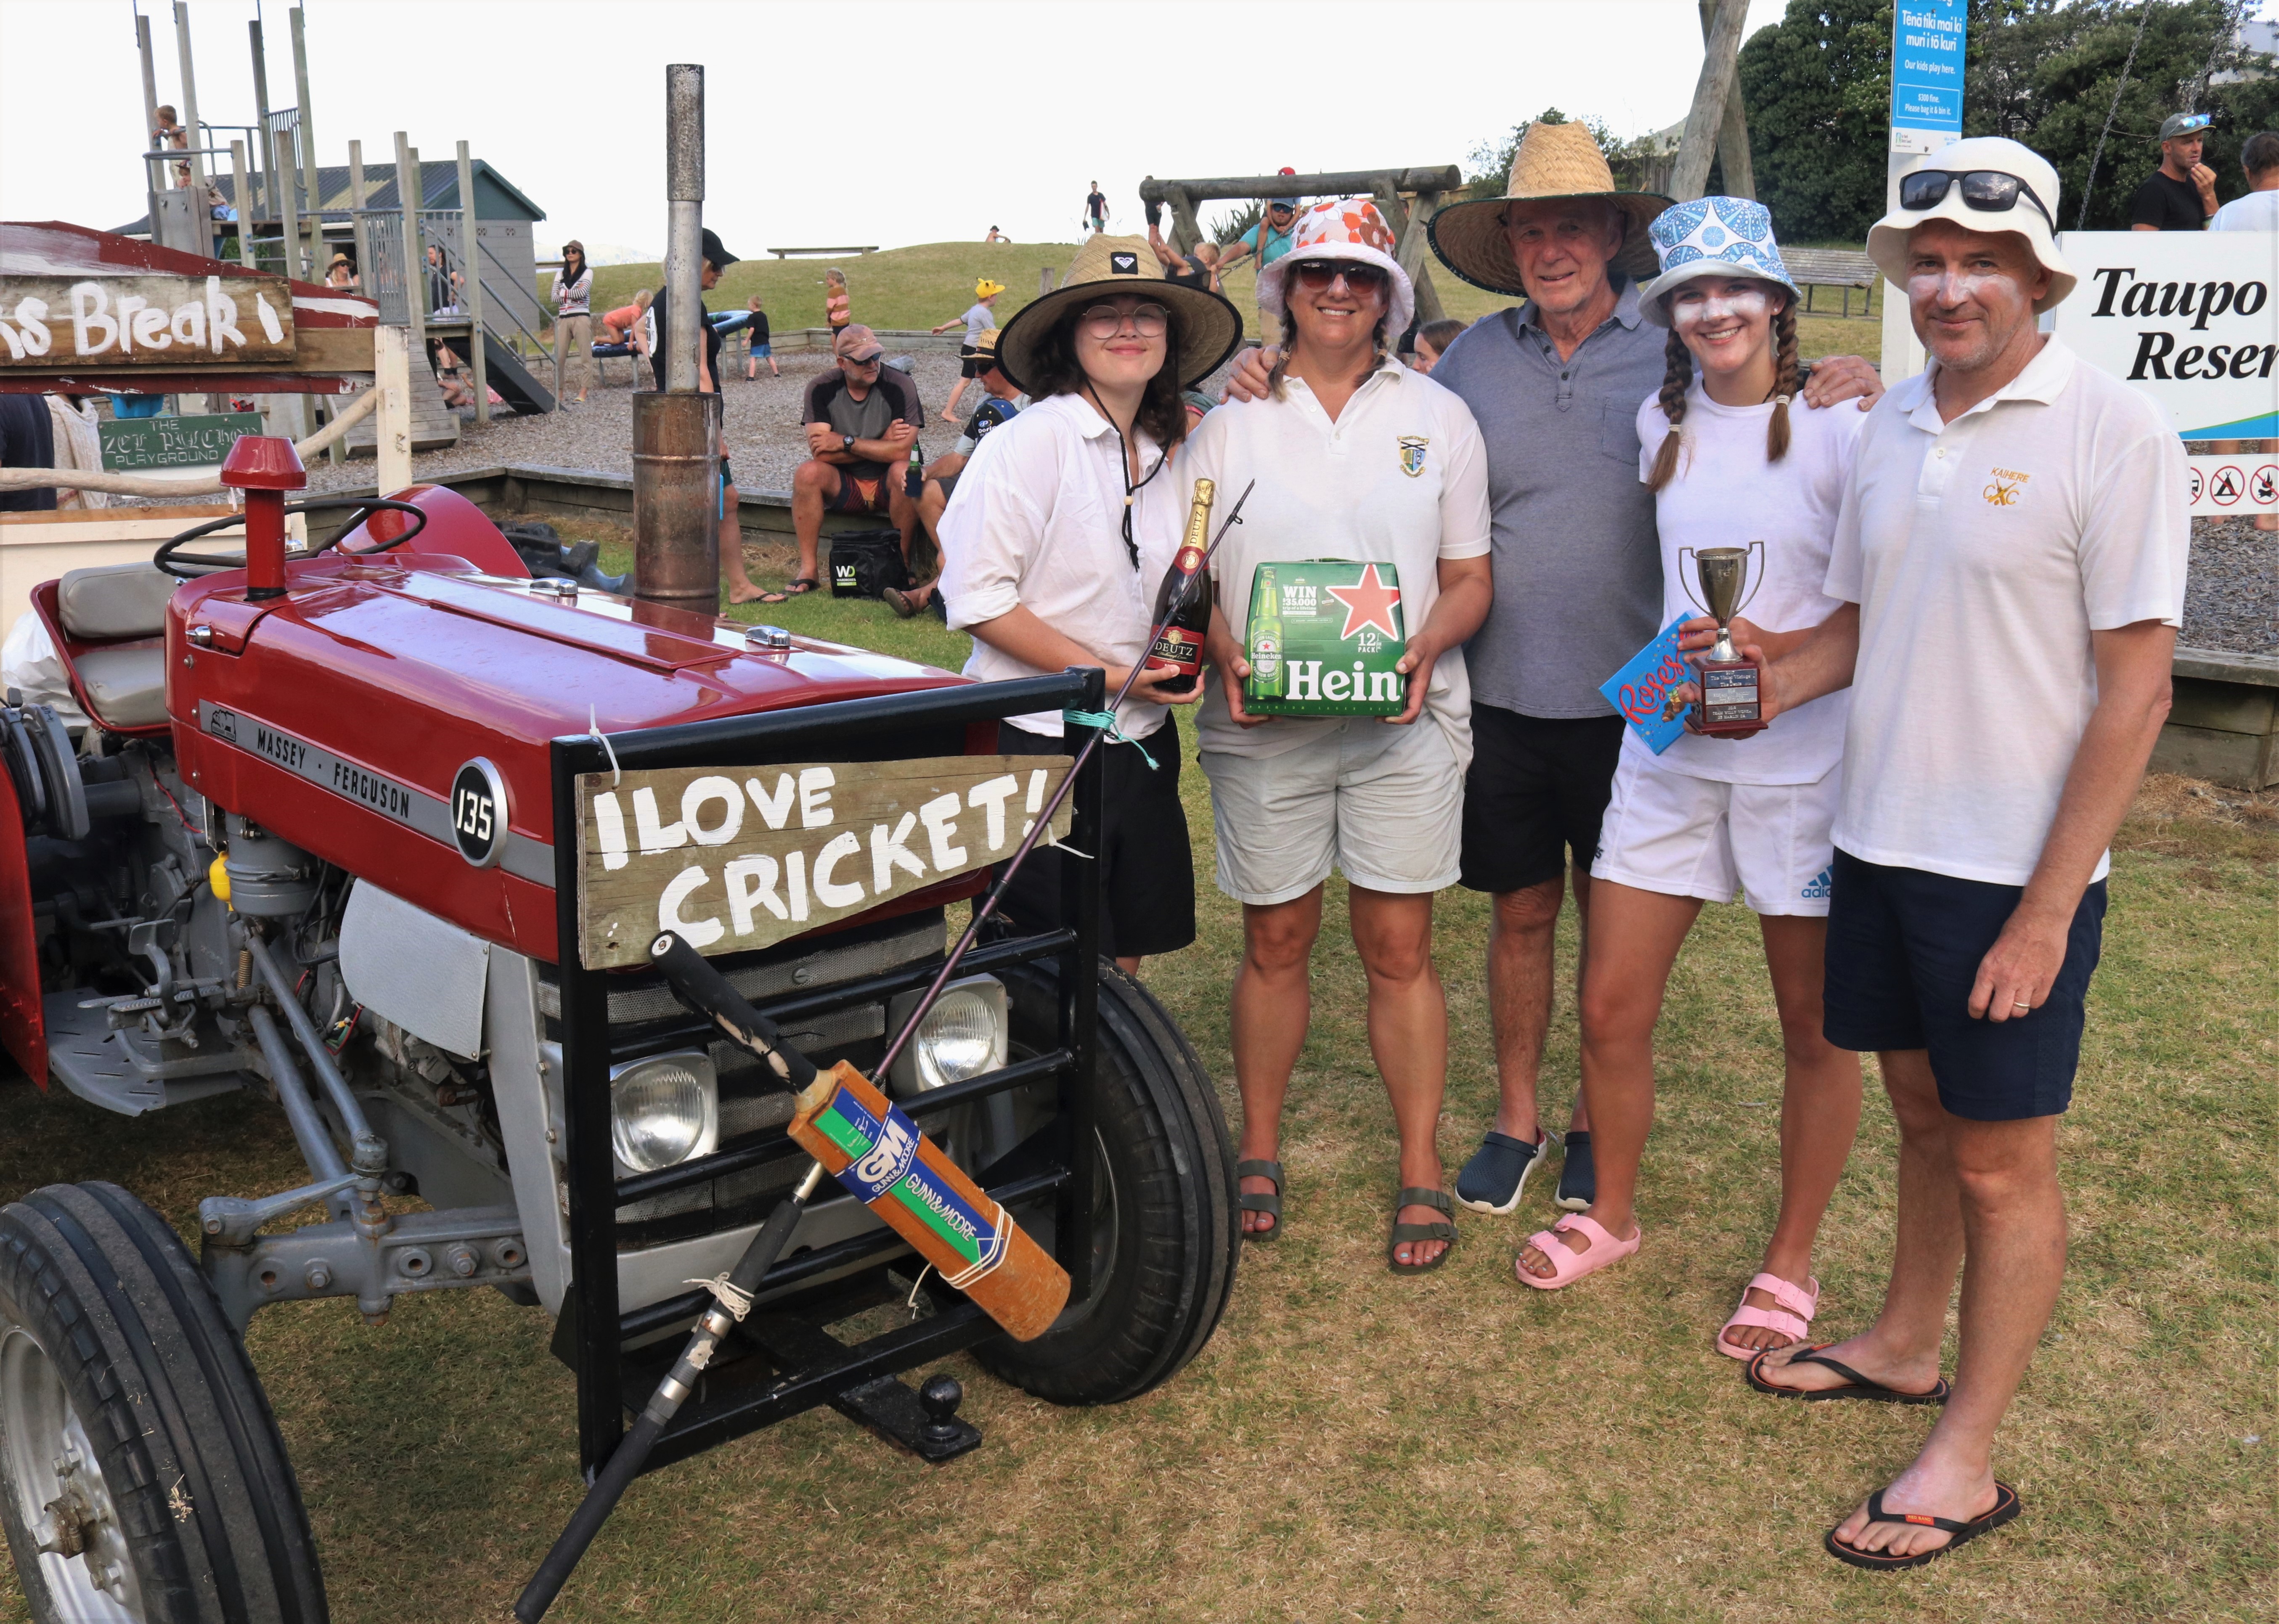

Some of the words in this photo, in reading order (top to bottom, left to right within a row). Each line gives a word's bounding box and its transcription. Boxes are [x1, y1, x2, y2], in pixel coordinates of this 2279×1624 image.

[1902, 10, 1922, 27] Tēnā
[1923, 13, 1936, 29] tiki
[1937, 16, 1953, 32] mai
[1954, 16, 1962, 33] ki
[1906, 32, 1925, 47] muri
[1931, 35, 1939, 49] tō
[1905, 59, 1915, 69] Our
[1917, 60, 1928, 71] kids
[1929, 62, 1941, 74] play
[1942, 64, 1955, 74] here.
[1918, 93, 1929, 102] $300
[1929, 94, 1940, 103] fine.
[1905, 103, 1919, 112] Please
[2091, 268, 2267, 330] Taupo
[71, 275, 246, 357] Break
[149, 420, 180, 431] THE
[115, 450, 218, 465] PLAYGROUND
[1990, 467, 2030, 483] KAIHERE
[1189, 511, 1203, 544] DEUTZ
[836, 565, 856, 577] WD
[1283, 586, 1317, 598] WIN
[1283, 598, 1317, 606] $35,000
[1358, 633, 1376, 646] 12
[1155, 641, 1193, 656] DEUTZ
[1286, 660, 1403, 701] Hein
[1619, 649, 1685, 725] Roses
[257, 728, 306, 769] MASSEY
[334, 762, 409, 819] FERGUSON
[456, 787, 493, 841] 135
[659, 769, 1048, 949] CRICKET!
[856, 1118, 909, 1183] GM
